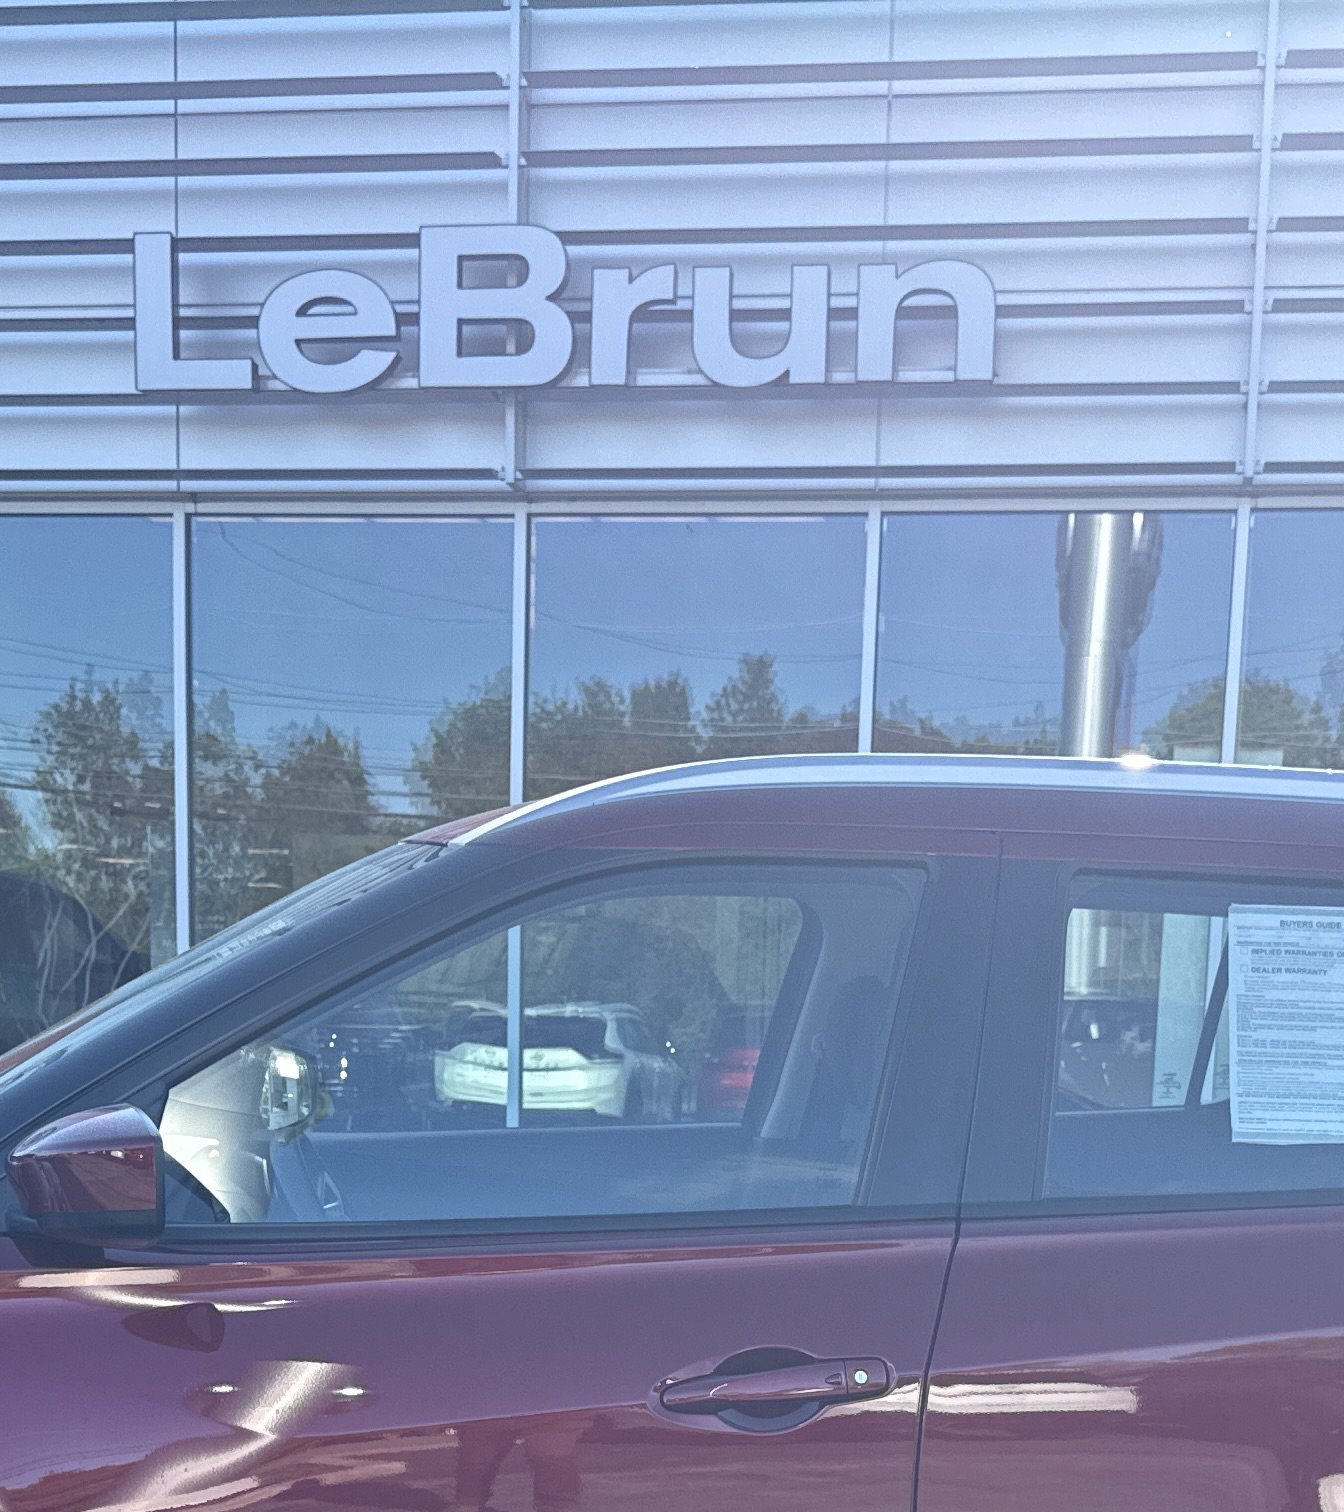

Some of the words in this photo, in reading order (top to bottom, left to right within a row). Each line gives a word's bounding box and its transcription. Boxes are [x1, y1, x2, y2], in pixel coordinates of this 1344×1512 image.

[133, 223, 998, 394] LeBrun
[1279, 919, 1313, 929] BUYERS
[1315, 921, 1342, 929] GUIDE
[1250, 966, 1283, 974] DEALER
[1284, 967, 1328, 976] WARRANTY
